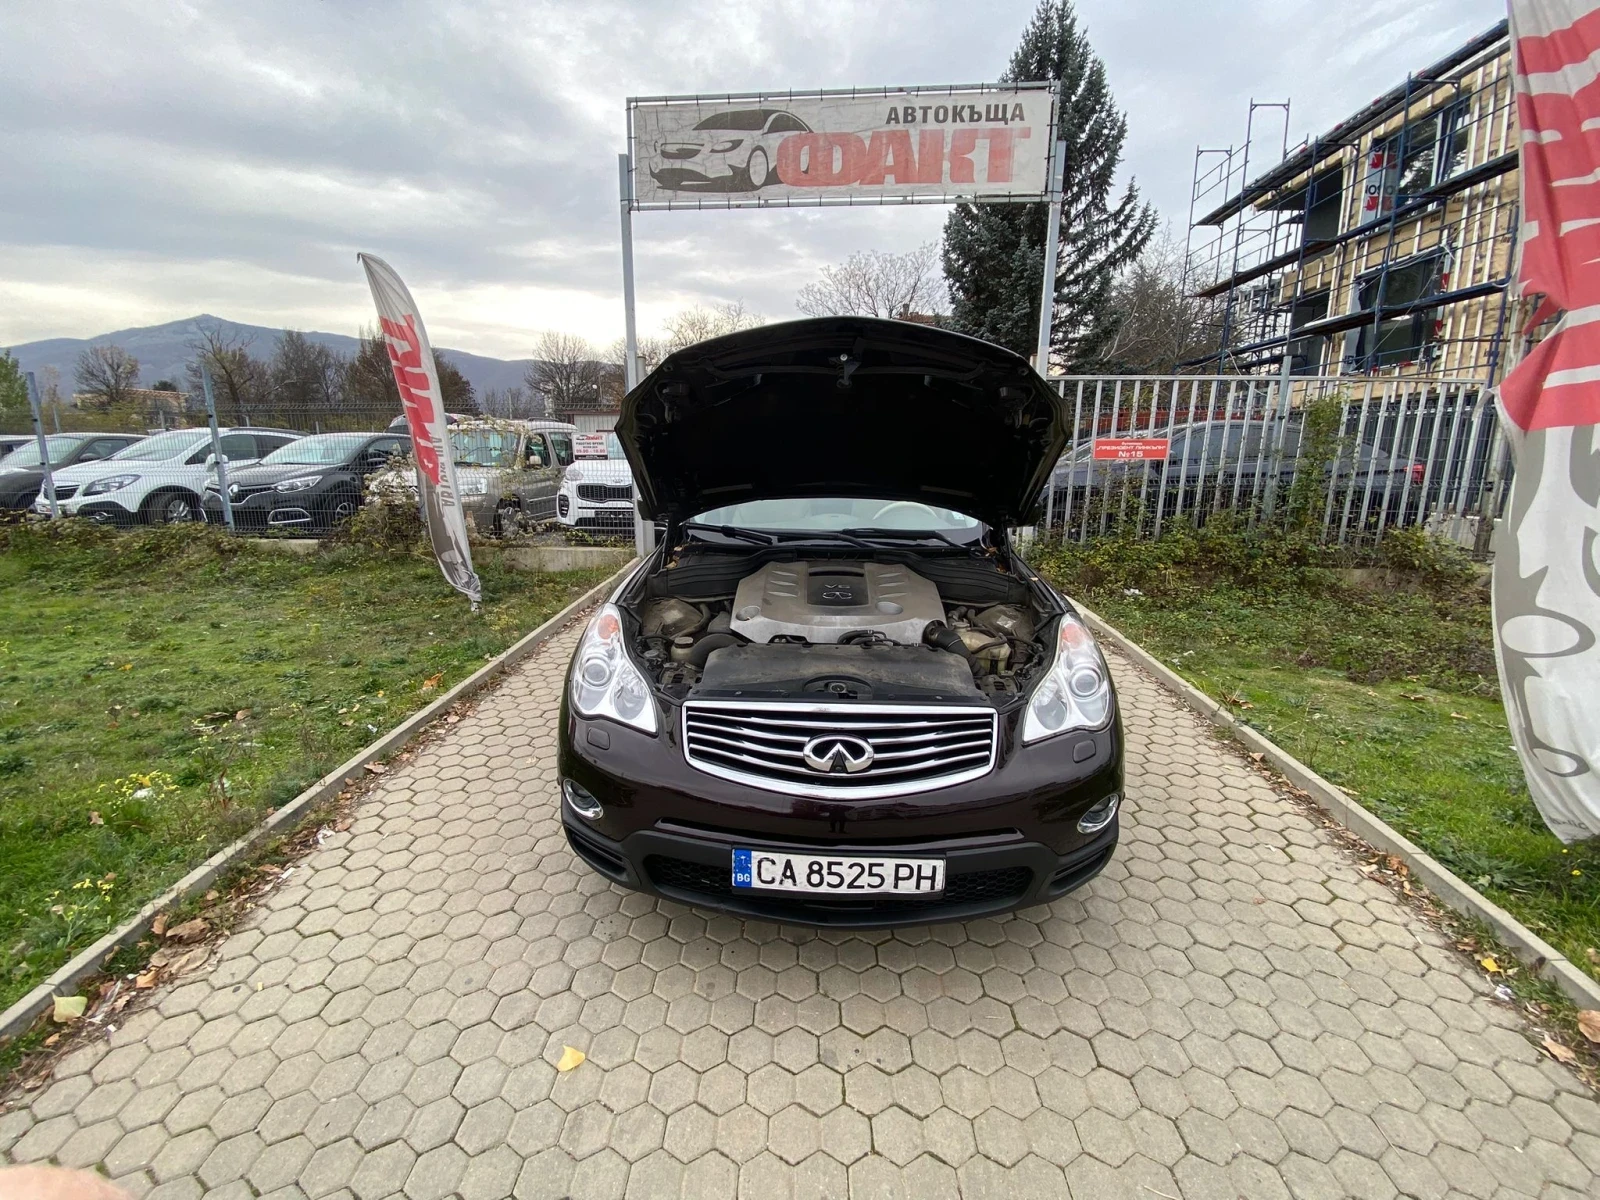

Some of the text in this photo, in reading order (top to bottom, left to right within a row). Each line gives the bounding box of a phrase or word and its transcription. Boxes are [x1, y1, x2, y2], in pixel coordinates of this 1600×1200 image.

[885, 102, 1025, 125] АВТОКЪЩА
[776, 127, 1032, 187] ФАКТ
[737, 857, 937, 891] BG CA 8525 PH
